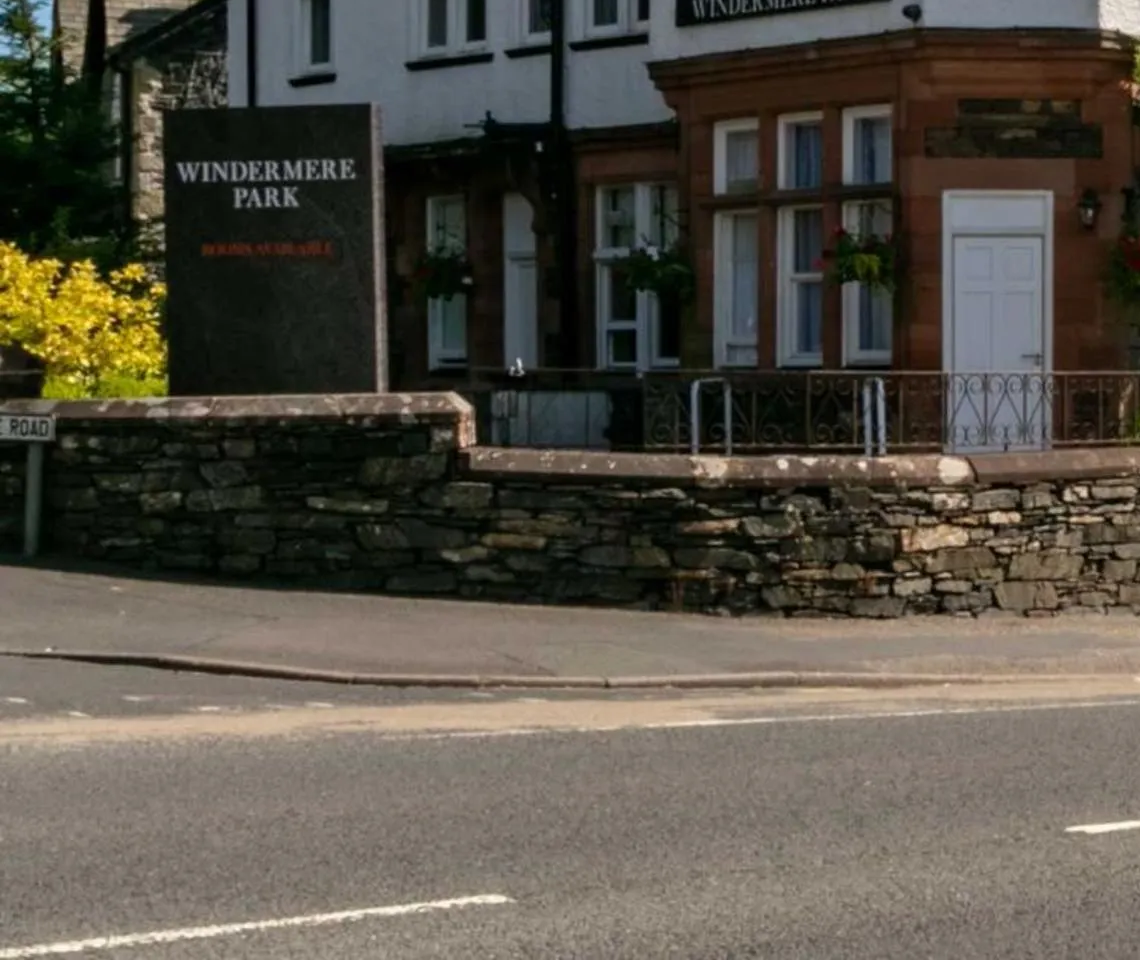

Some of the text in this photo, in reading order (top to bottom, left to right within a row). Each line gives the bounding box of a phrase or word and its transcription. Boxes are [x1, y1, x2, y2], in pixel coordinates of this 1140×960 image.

[176, 158, 356, 184] WINDERMERE
[233, 186, 300, 209] PARK
[10, 419, 49, 437] ROAD
